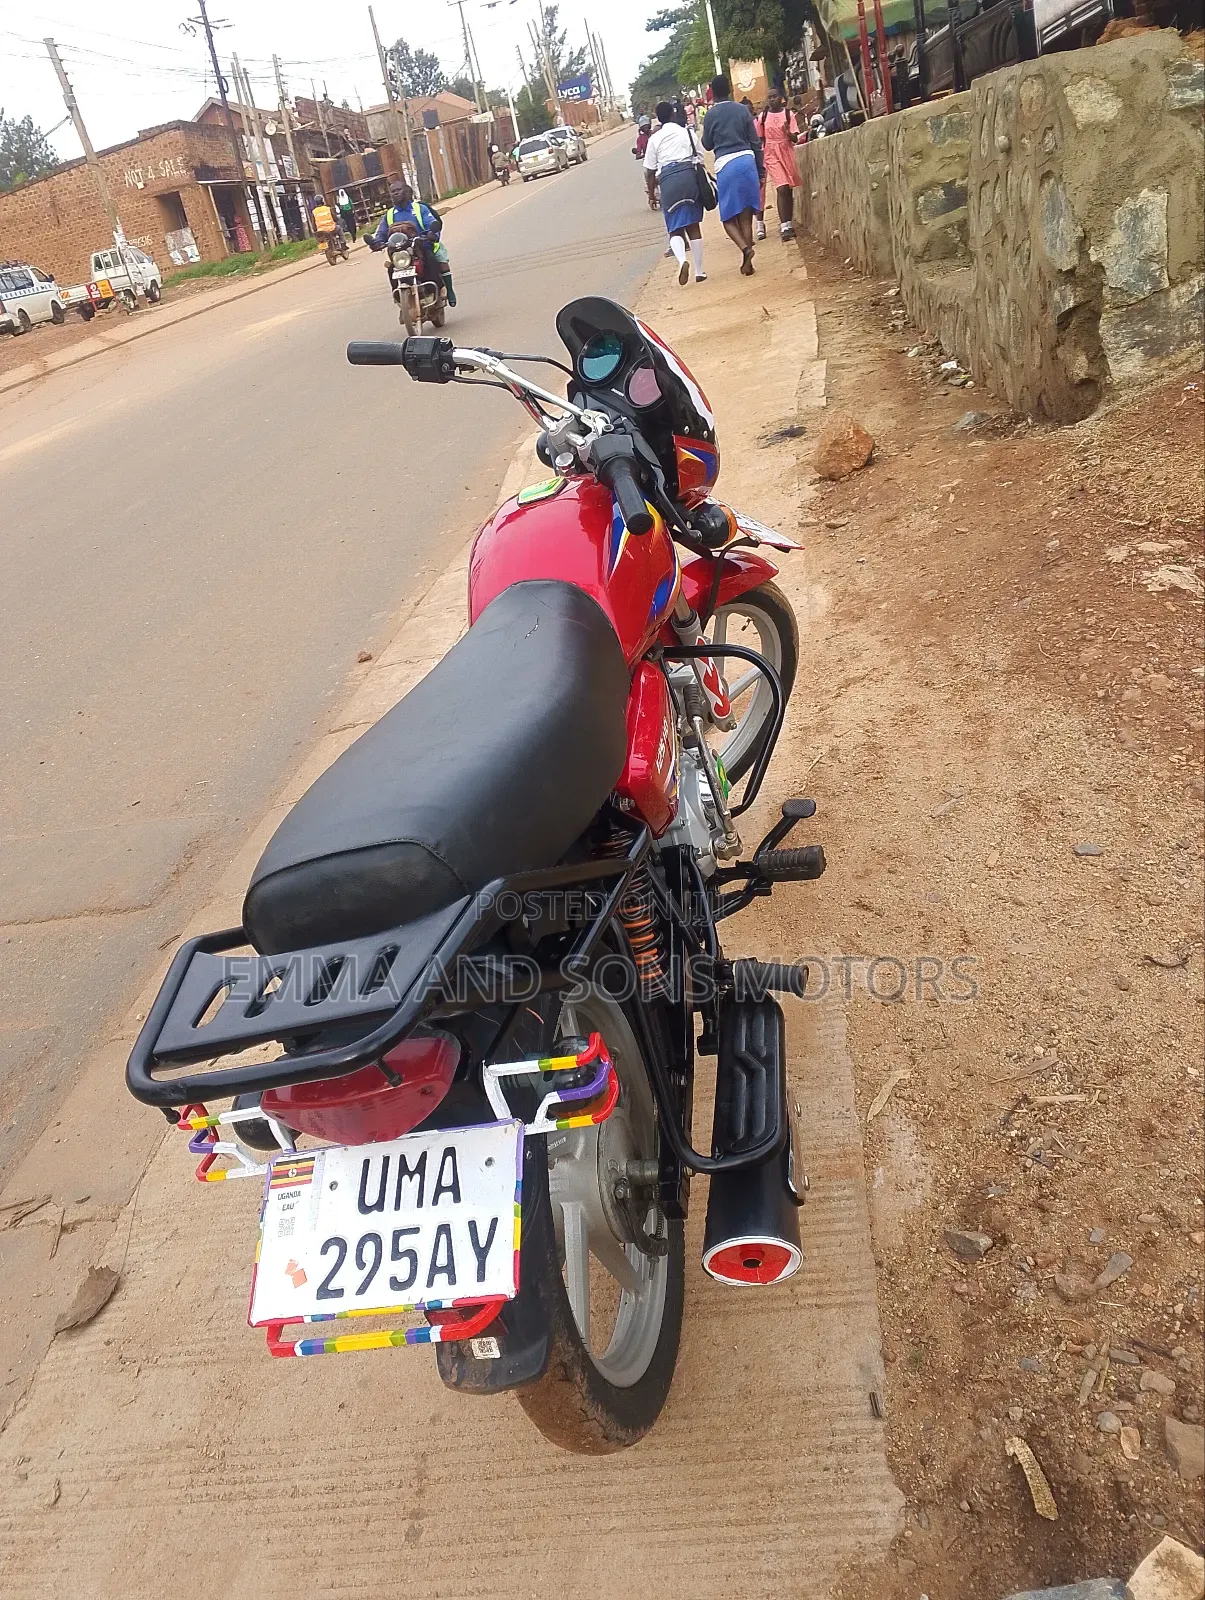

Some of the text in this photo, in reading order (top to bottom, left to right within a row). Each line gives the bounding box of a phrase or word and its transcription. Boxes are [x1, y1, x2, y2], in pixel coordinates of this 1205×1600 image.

[124, 168, 144, 188] NOT
[358, 1146, 461, 1214] UMA
[316, 1217, 498, 1300] 295AY
